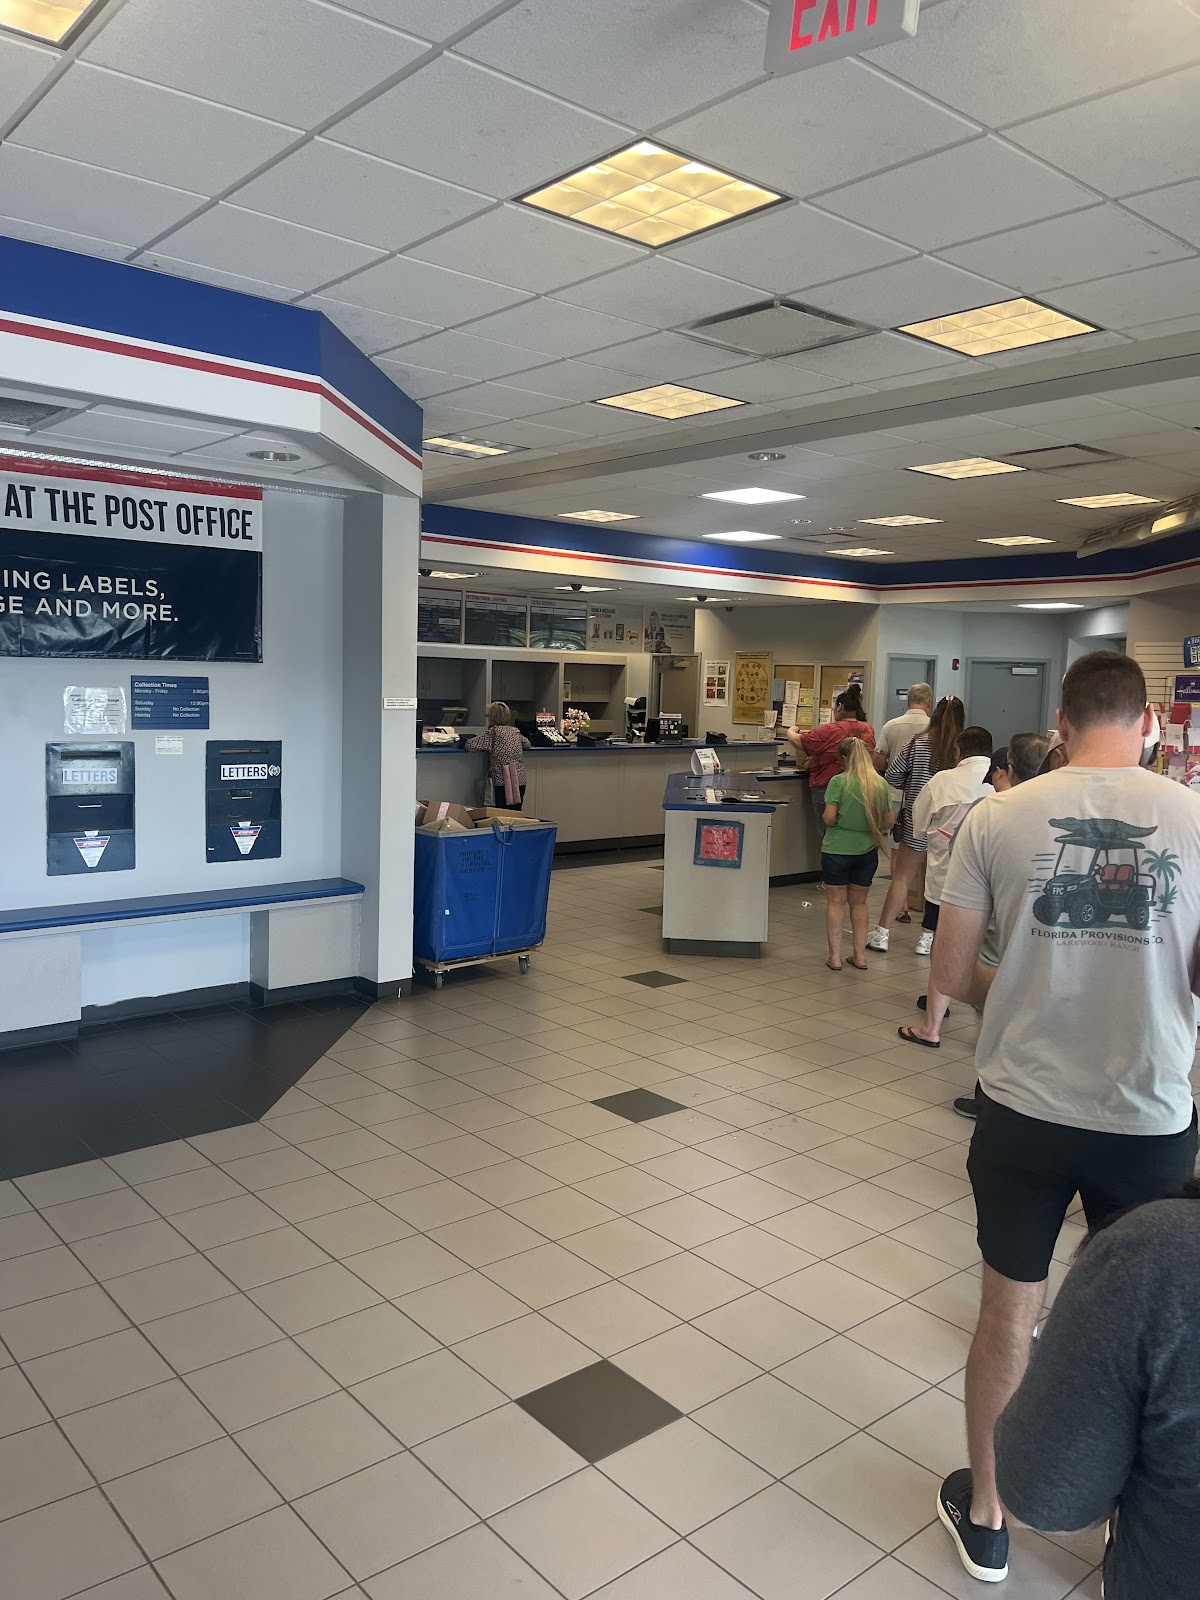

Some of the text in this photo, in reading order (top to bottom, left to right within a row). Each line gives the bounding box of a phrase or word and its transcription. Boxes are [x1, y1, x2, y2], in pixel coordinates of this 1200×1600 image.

[4, 483, 254, 541] AT THE POST OFFICE
[3, 569, 166, 600] ING LABELS,
[35, 598, 92, 618] AND
[103, 601, 179, 622] MORE.
[64, 769, 116, 782] LETTERS
[222, 766, 266, 778] LETTERS
[1052, 886, 1064, 896] FPC
[1031, 928, 1077, 938] FLORIDA
[1080, 930, 1150, 945] PROVISIONS
[1110, 941, 1140, 952] RANCH
